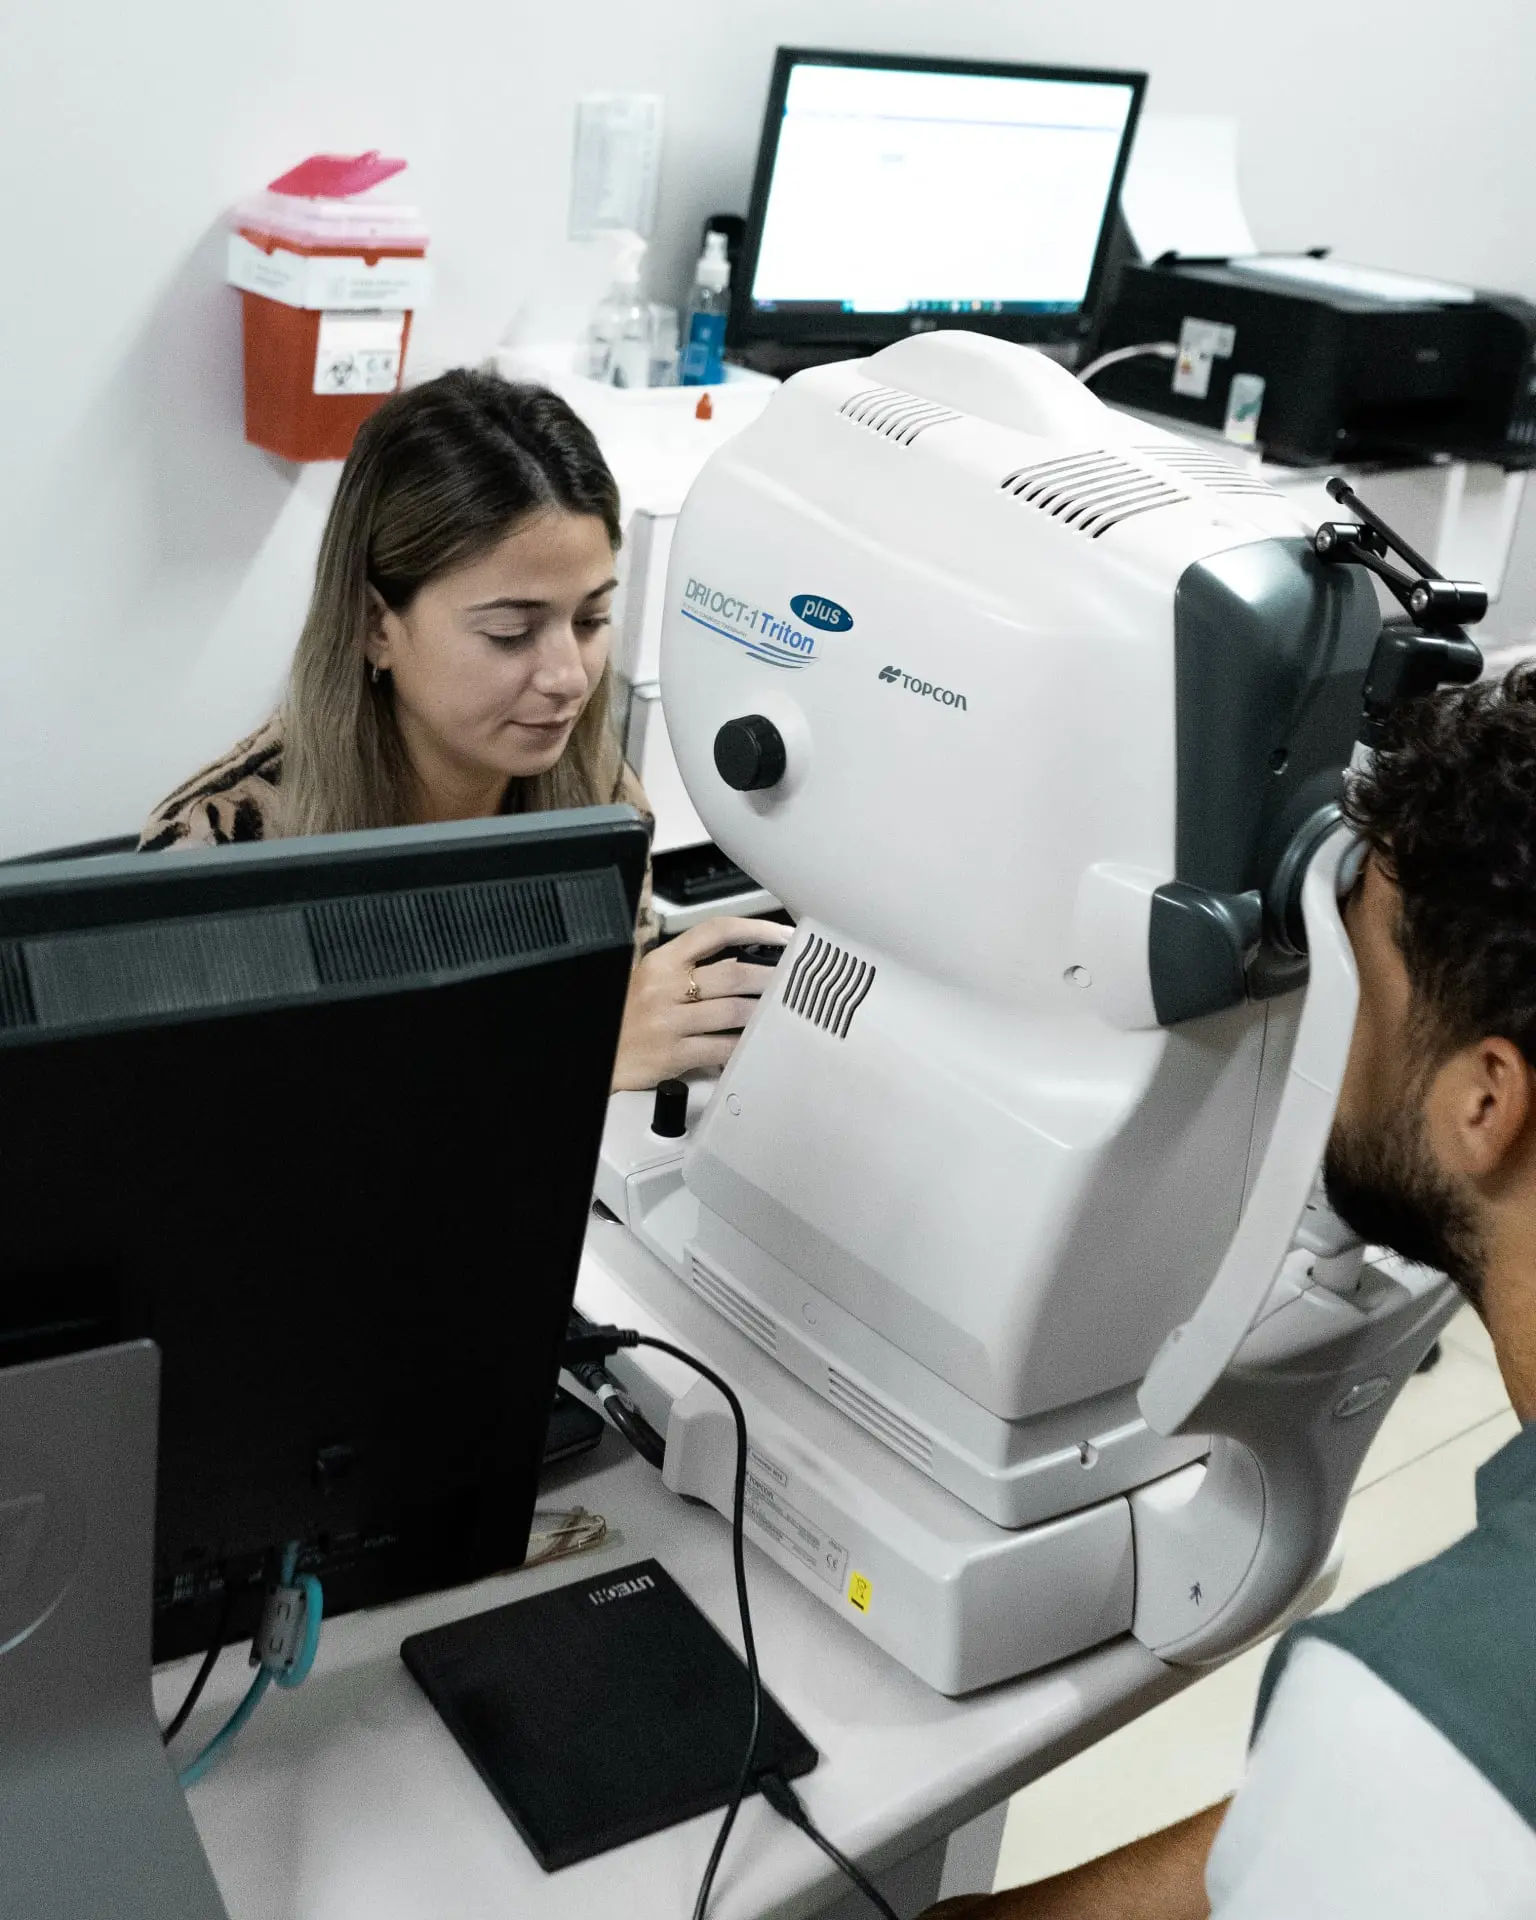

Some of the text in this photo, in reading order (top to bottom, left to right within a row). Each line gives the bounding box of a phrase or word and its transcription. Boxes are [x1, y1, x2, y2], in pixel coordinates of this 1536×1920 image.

[685, 578, 711, 607] DRI
[710, 591, 758, 629] OCT-1
[760, 612, 815, 654] Triton
[801, 599, 842, 625] plus
[902, 673, 967, 711] TOPCON
